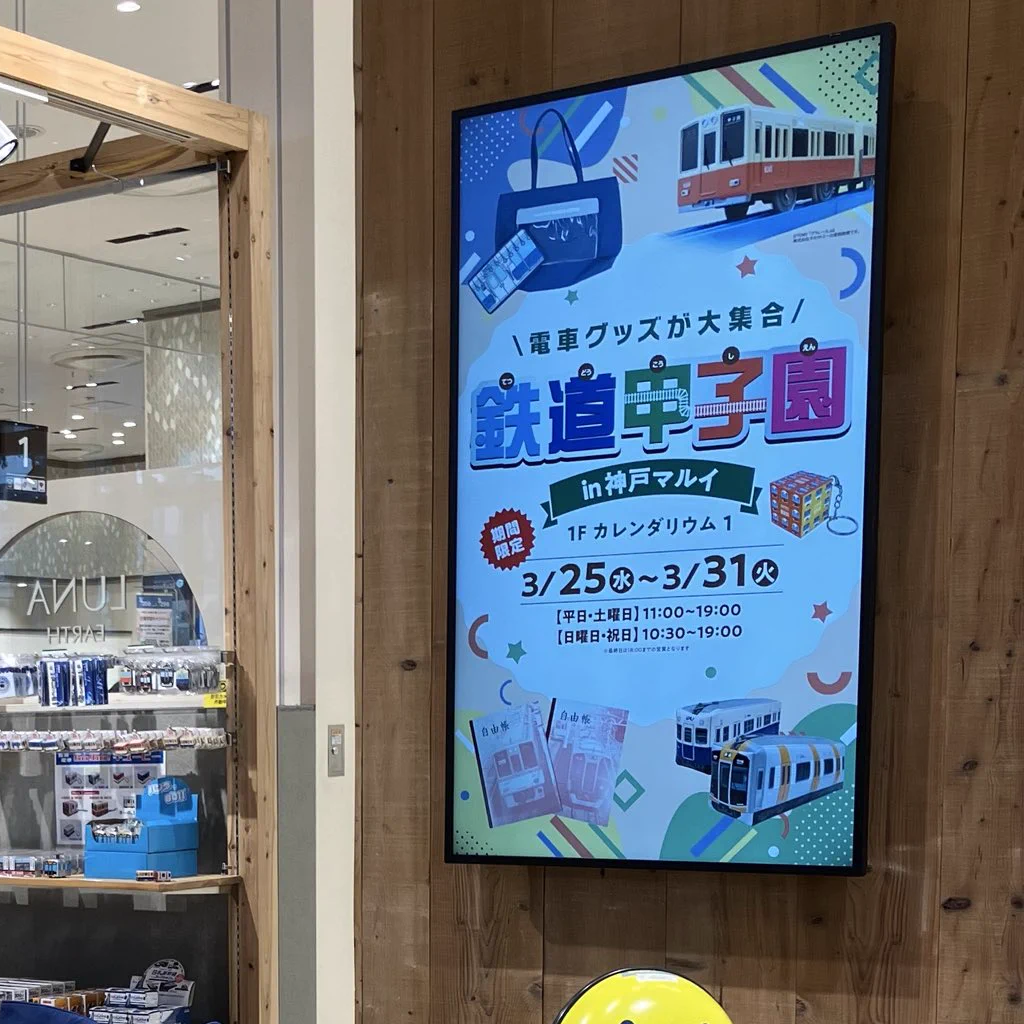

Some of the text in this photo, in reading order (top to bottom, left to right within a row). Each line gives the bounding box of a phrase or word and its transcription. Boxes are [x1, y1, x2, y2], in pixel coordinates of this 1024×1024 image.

[802, 343, 816, 351] えん
[652, 360, 664, 368] こう
[474, 347, 846, 460] 鉄道甲子園
[18, 436, 29, 468] 1
[490, 519, 521, 543] 期間
[567, 515, 732, 542] 1F カレンダリウム 1
[494, 537, 525, 561] 限定
[481, 720, 510, 737] 自由帳
[560, 710, 591, 725] 自由帳
